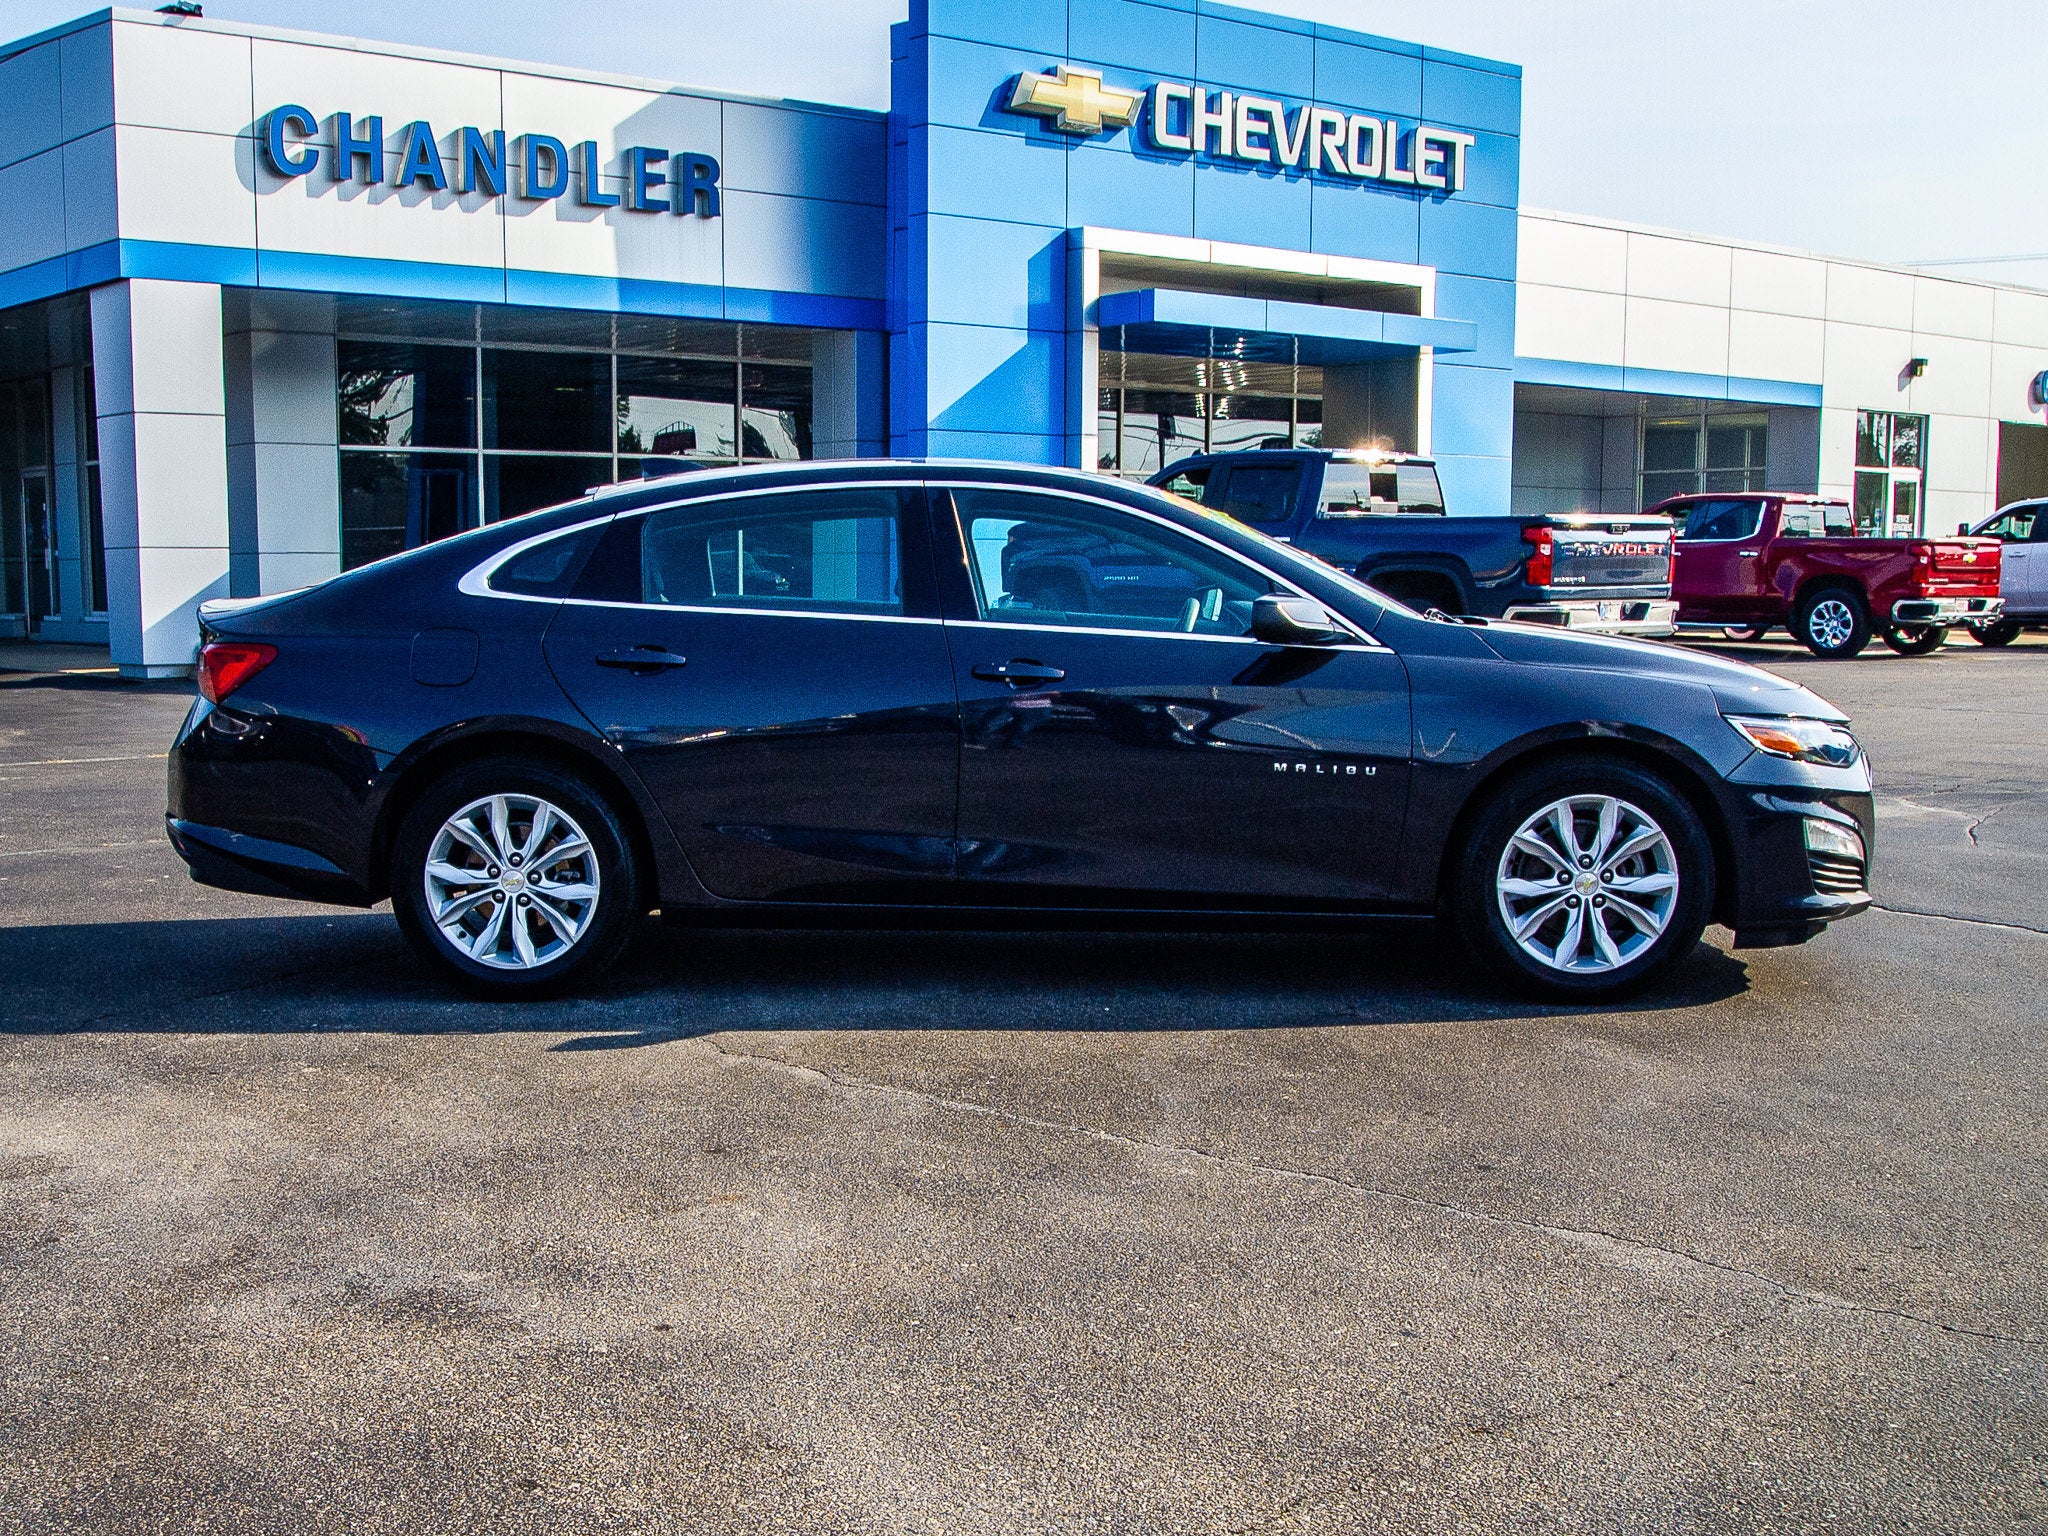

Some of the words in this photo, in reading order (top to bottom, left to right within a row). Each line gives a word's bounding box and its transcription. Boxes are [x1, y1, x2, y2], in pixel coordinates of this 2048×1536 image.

[263, 104, 721, 218] CHANDLER
[1151, 81, 1476, 191] CHEVROLET
[1273, 762, 1377, 776] MALIBU
